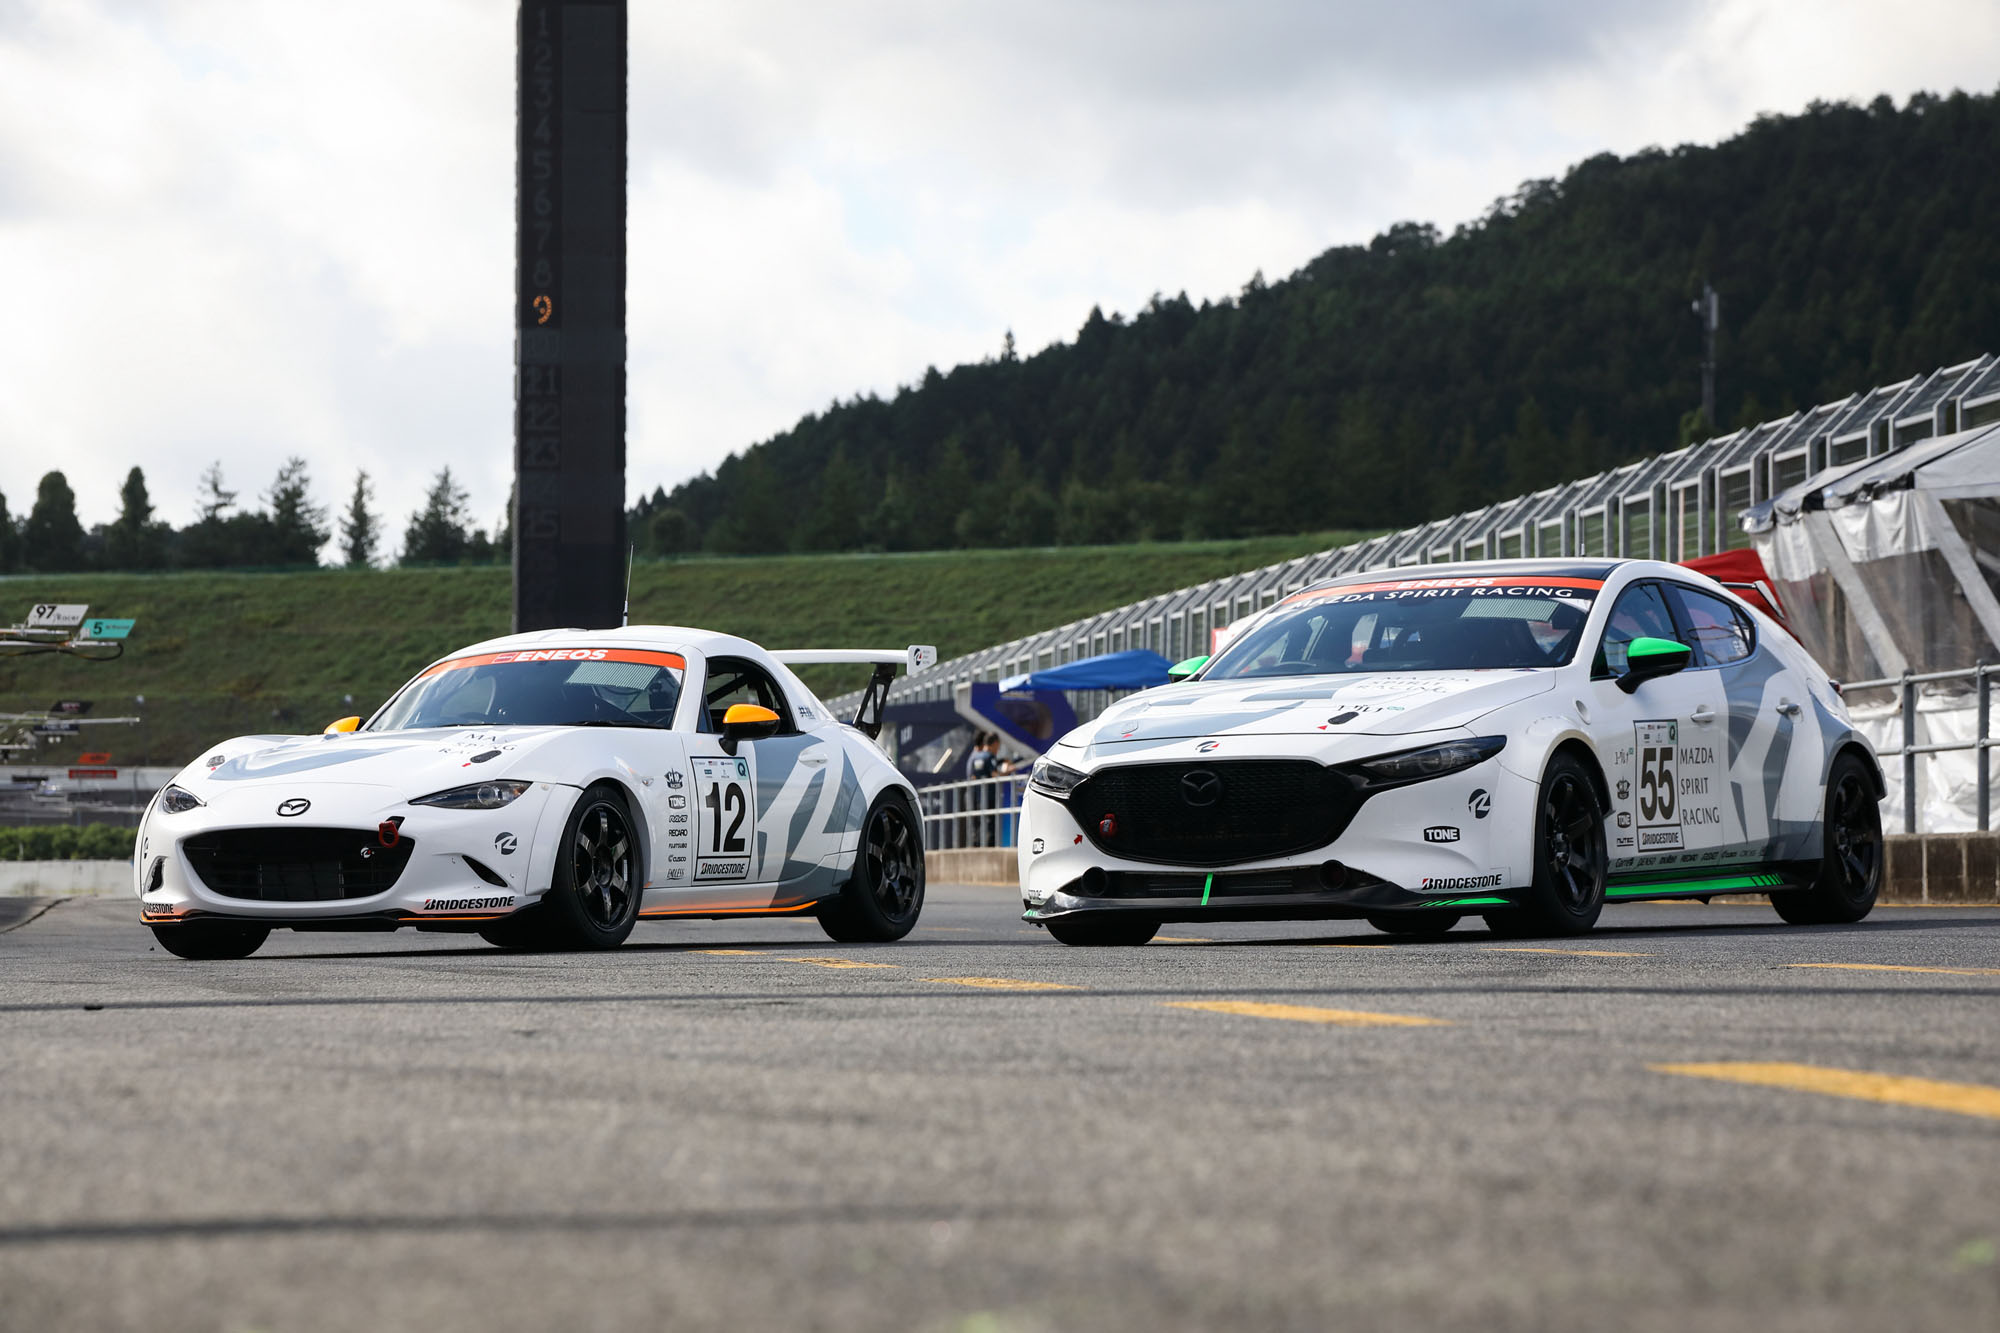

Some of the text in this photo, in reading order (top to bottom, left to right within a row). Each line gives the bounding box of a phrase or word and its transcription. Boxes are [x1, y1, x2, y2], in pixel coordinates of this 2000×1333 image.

[533, 113, 552, 144] 4
[533, 149, 552, 180] 5
[533, 187, 552, 216] 6
[532, 295, 552, 325] 9
[1397, 578, 1496, 589] ENEOS
[1384, 588, 1464, 600] SPIRIT
[1470, 587, 1574, 598] RACING
[36, 605, 57, 620] 97
[93, 622, 103, 635] 5
[514, 649, 609, 662] ENEOS
[1669, 726, 1676, 741] Q
[1680, 747, 1714, 765] MAZDA
[738, 762, 746, 776] Q
[1640, 746, 1675, 822] 55
[1681, 777, 1709, 795] SPIRIT
[669, 796, 685, 807] TONE
[705, 781, 746, 853] 12
[1682, 806, 1720, 826] RACING
[1426, 829, 1458, 840] TONE
[1642, 832, 1679, 845] BRIDGESTONE
[700, 862, 745, 875] BRIDGESTONE
[1421, 874, 1502, 891] BRIDGESTONE
[424, 896, 515, 911] BRIDGESTONE
